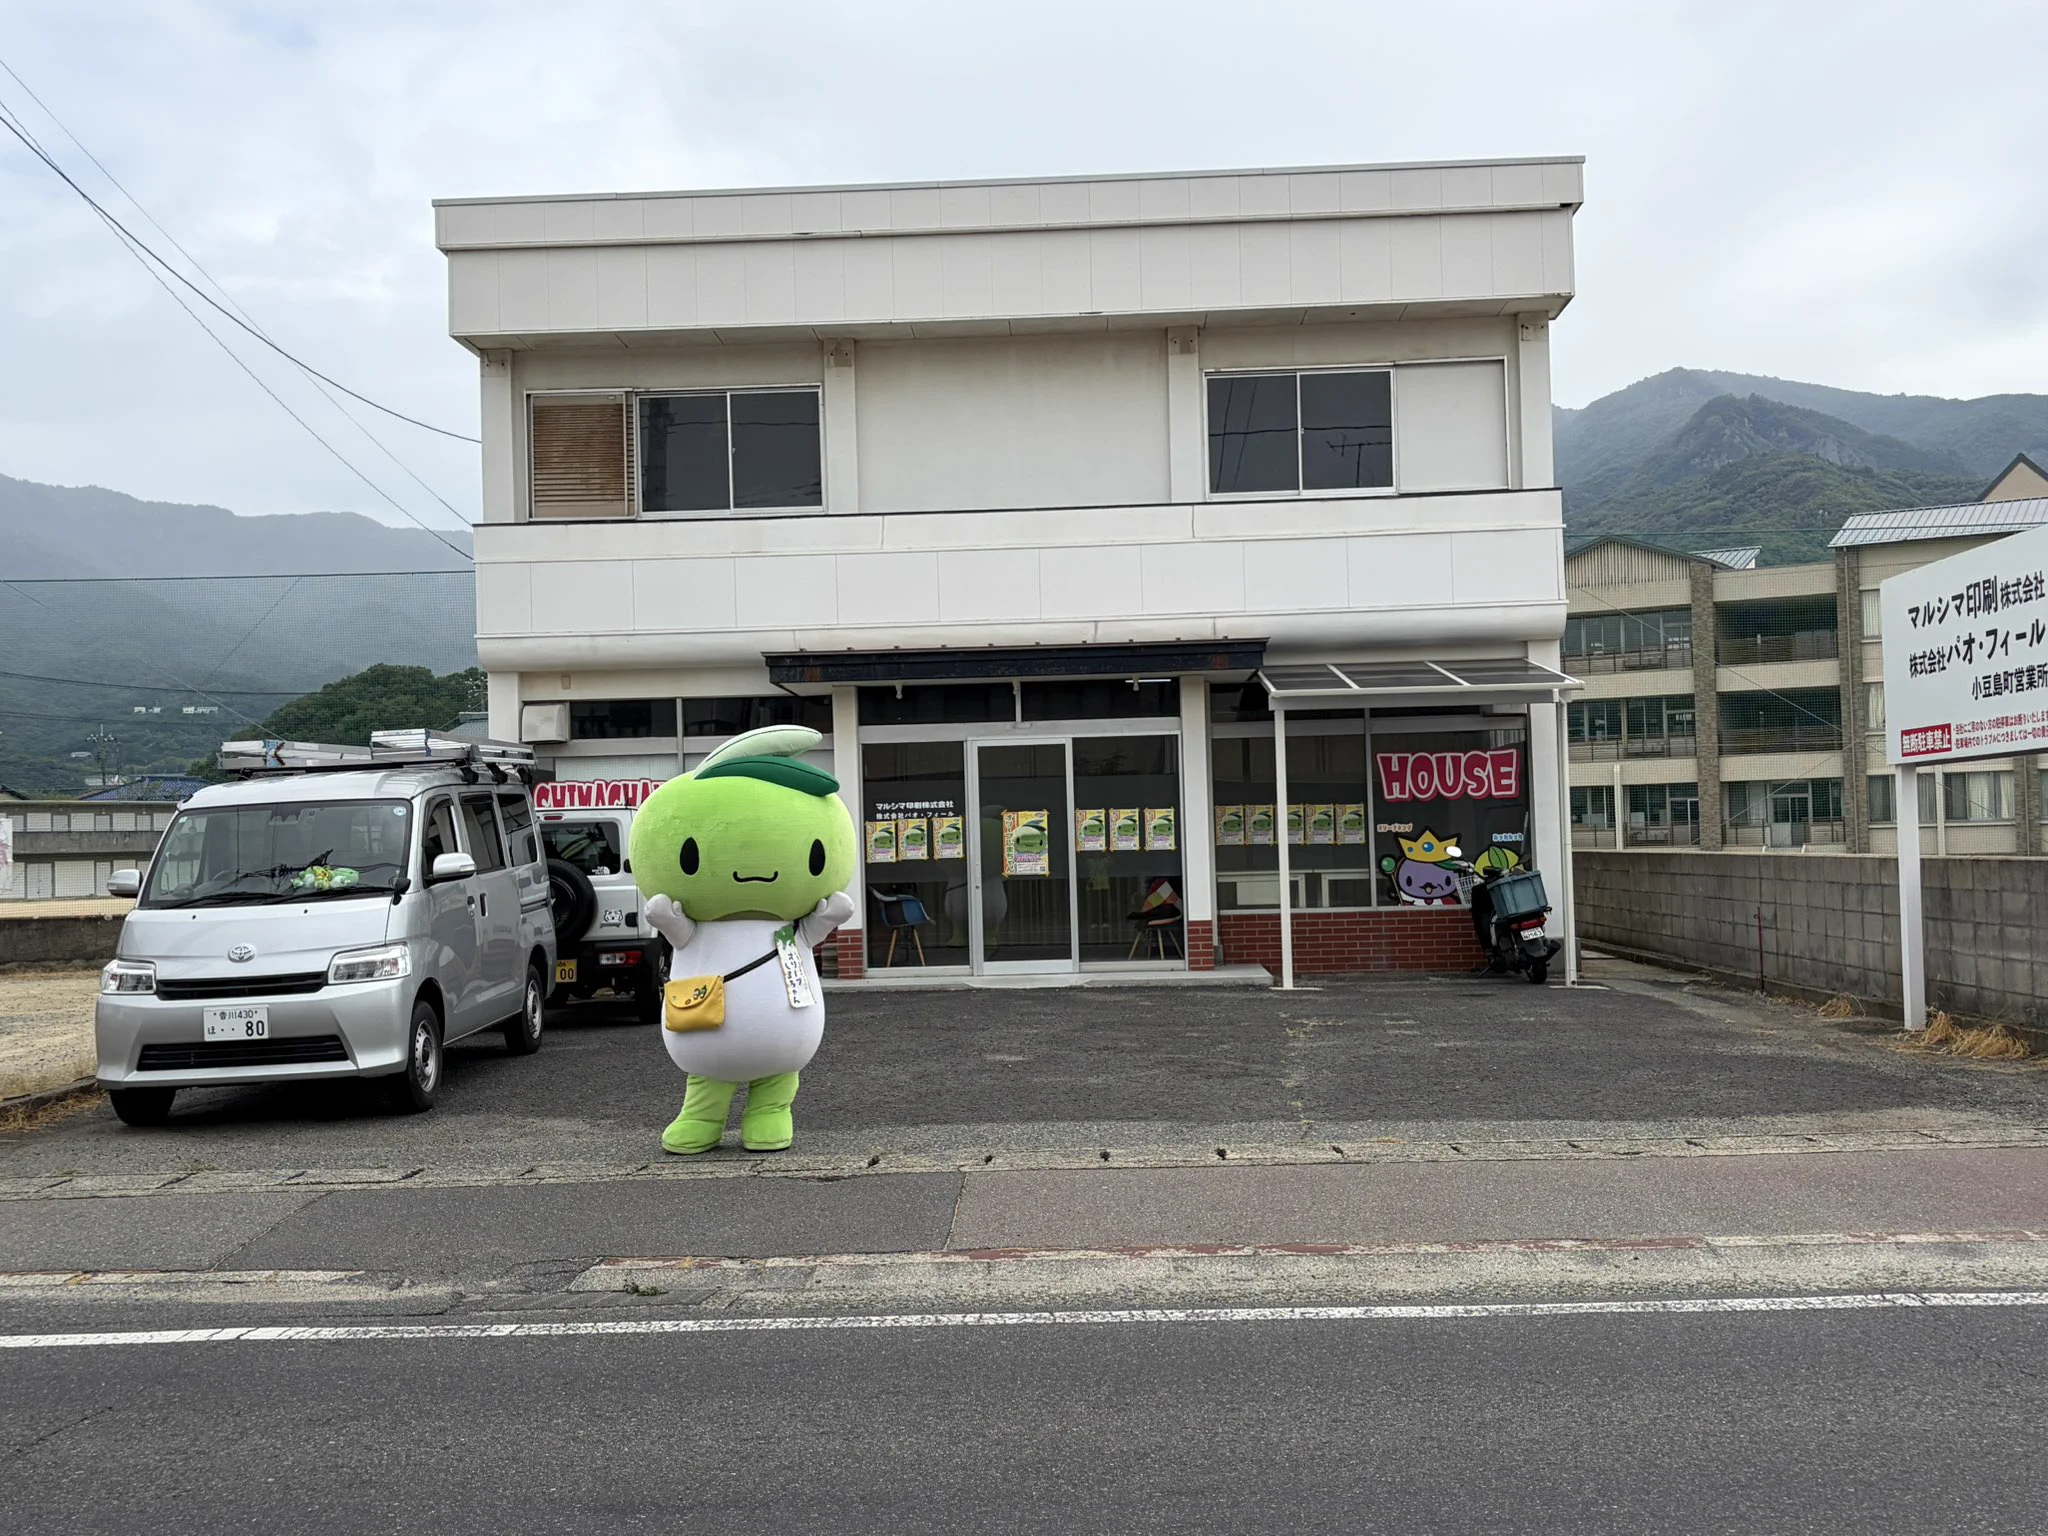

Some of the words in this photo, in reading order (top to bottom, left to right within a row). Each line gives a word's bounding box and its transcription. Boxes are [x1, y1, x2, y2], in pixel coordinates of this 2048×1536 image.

[1907, 570, 2046, 629] マルシマ印刷株式会社
[1972, 662, 2048, 701] 小豆島町営業所
[1902, 727, 1951, 754] 無断駐車禁止
[1376, 749, 1521, 802] HOUSE
[875, 800, 954, 810] マルシマ印刷株式会社
